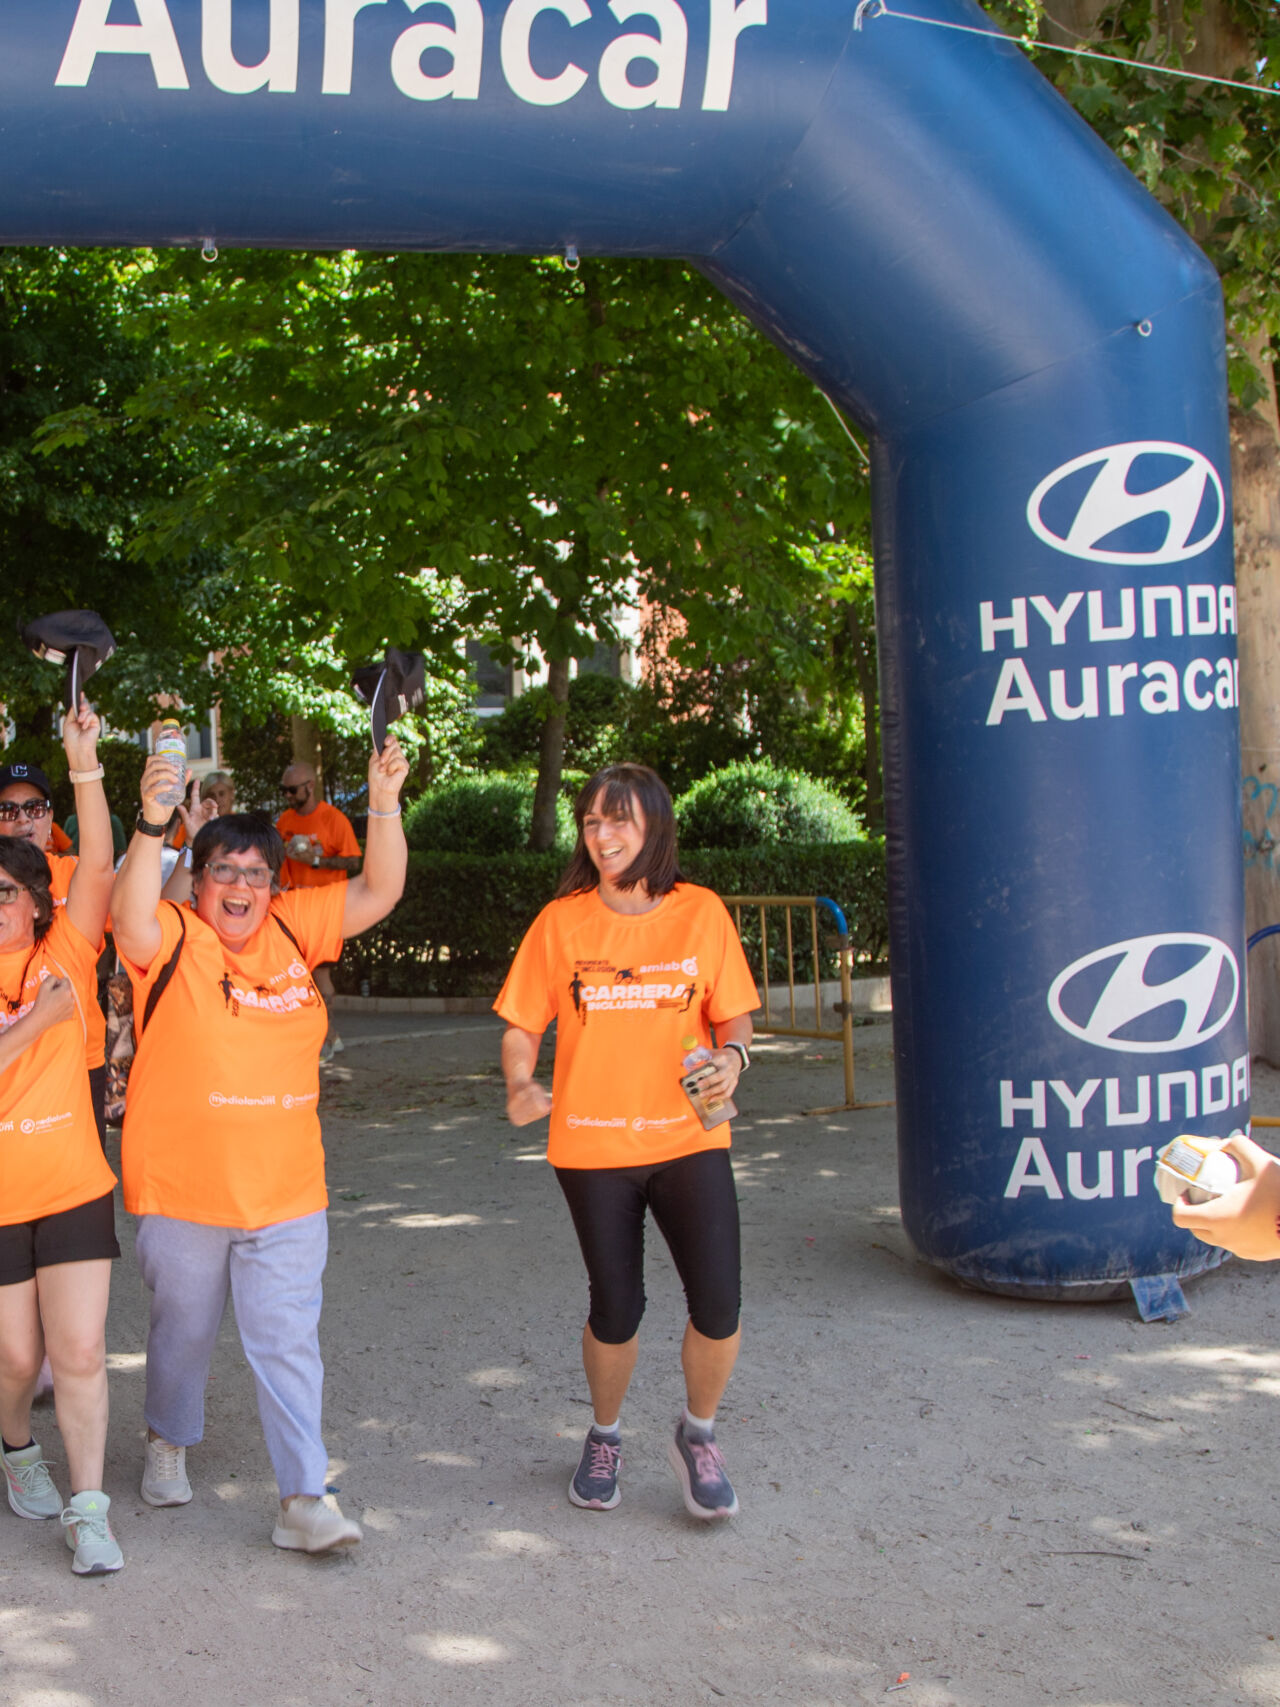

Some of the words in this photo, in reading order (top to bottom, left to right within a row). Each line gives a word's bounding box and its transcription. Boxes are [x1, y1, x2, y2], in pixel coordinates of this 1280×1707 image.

[54, 0, 768, 111] Auracar
[640, 961, 681, 974] amiab
[581, 983, 688, 1001] CARRERA
[586, 1000, 657, 1011] INCLUSIVA
